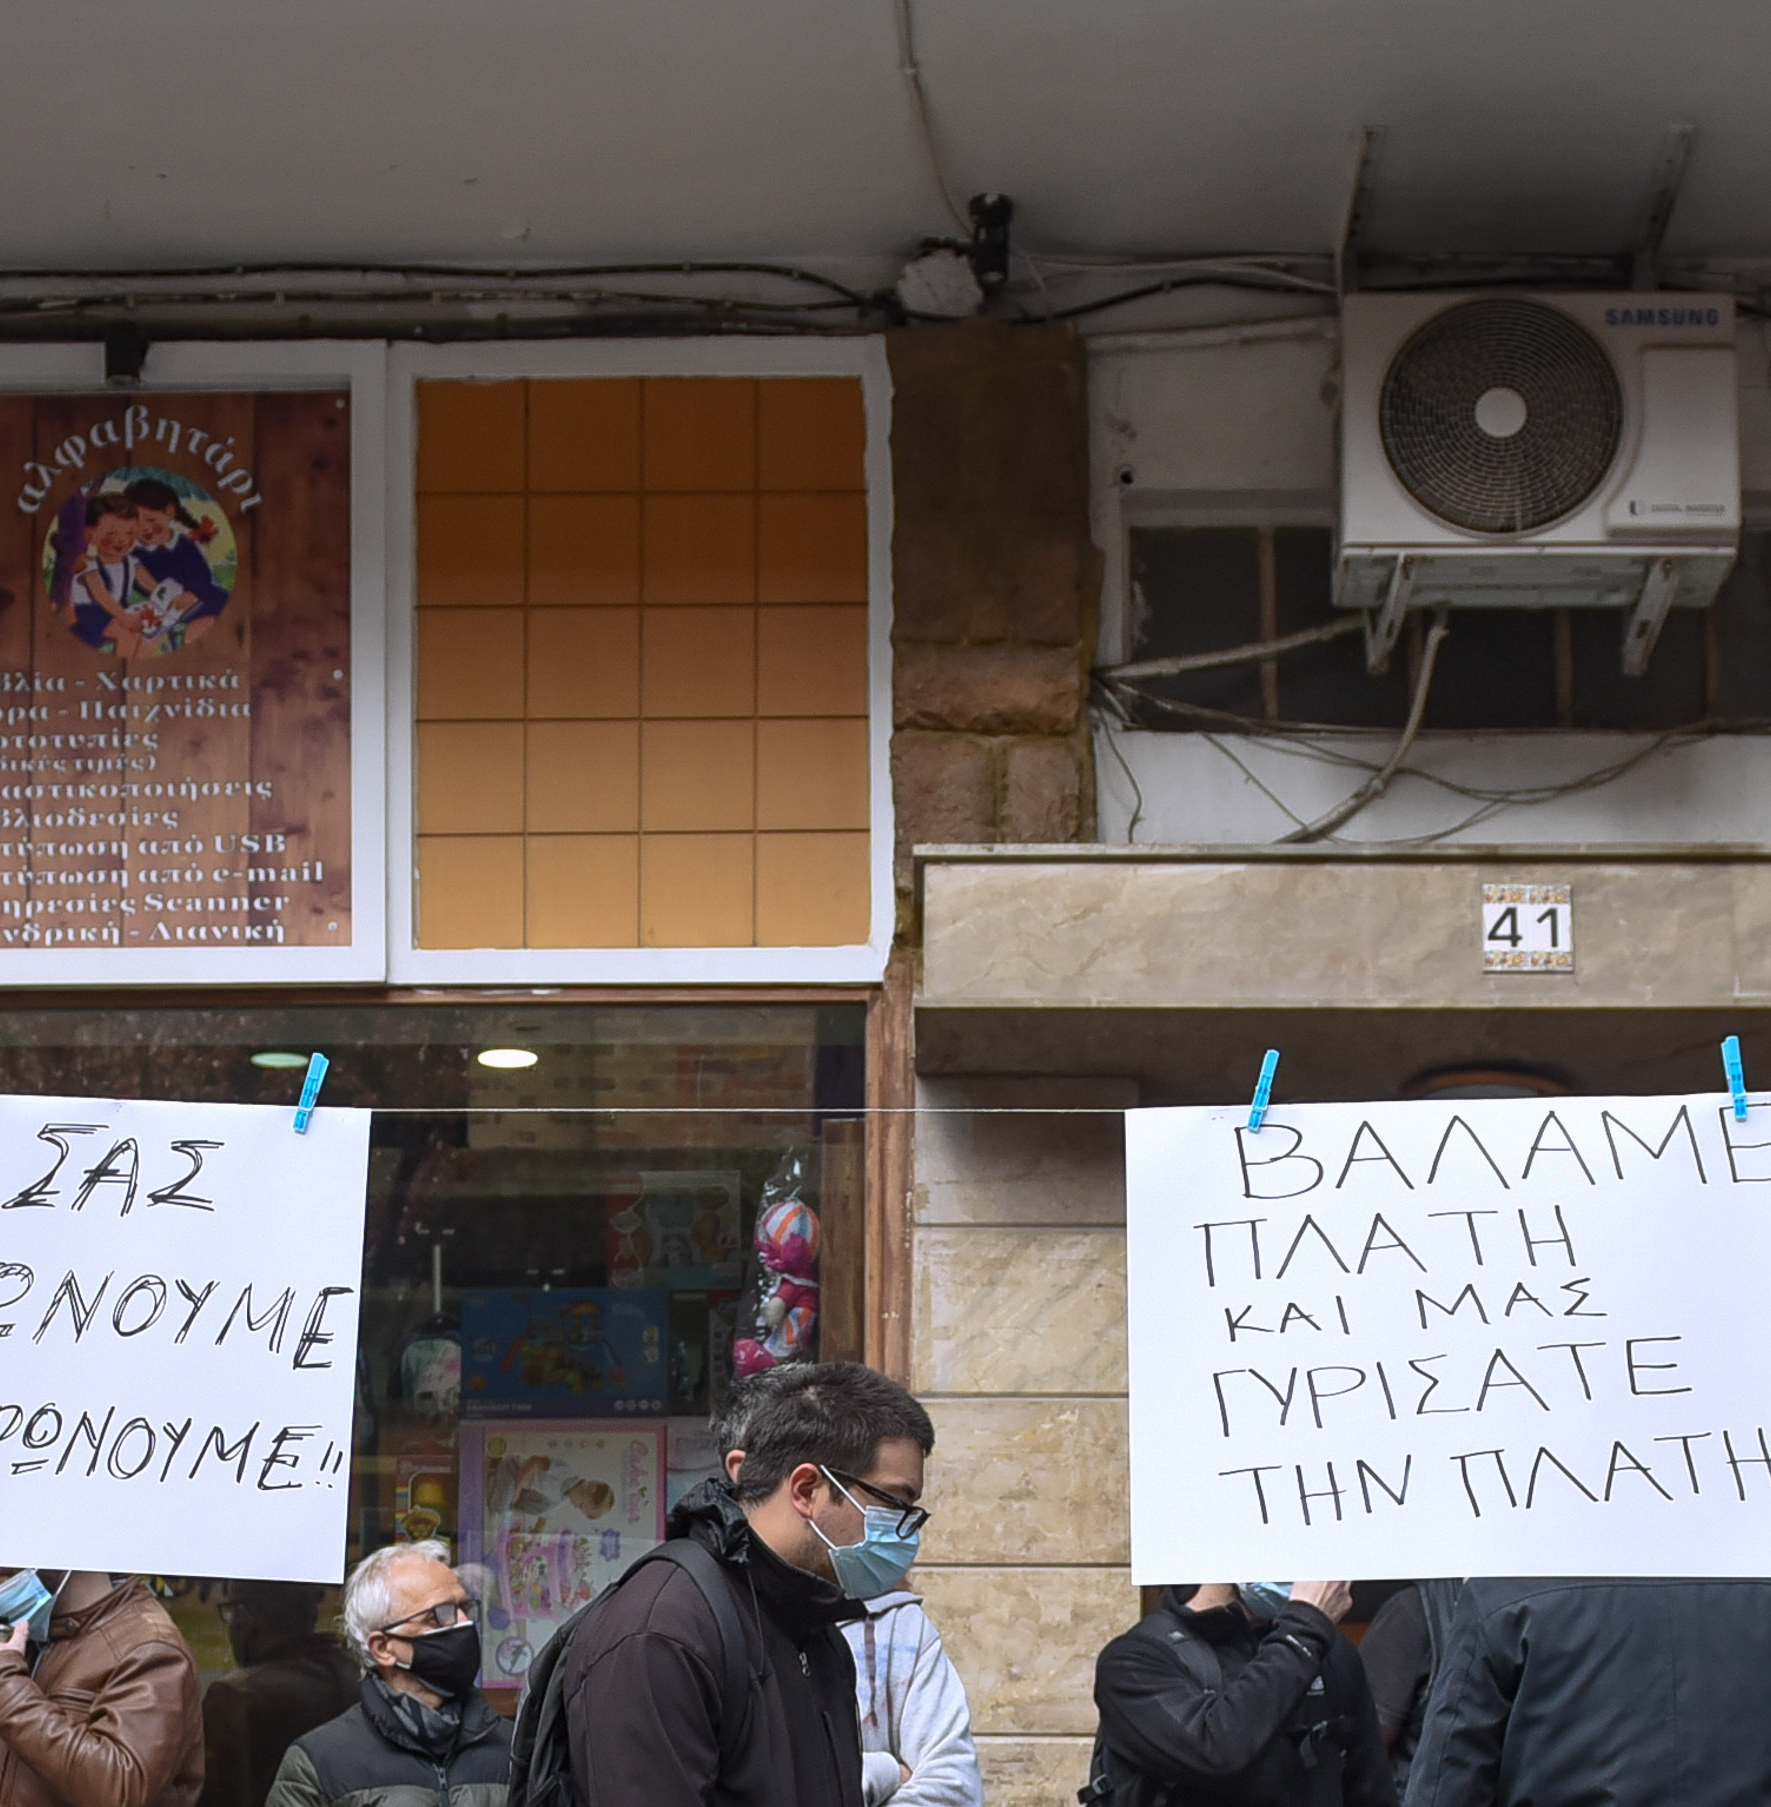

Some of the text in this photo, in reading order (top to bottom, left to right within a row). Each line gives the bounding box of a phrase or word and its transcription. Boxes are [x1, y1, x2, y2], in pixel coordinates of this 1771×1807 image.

[1606, 307, 1719, 326] SAMSUNG
[16, 403, 263, 514] αλφαβητάρι
[95, 669, 240, 694] Χαρτικά
[79, 697, 252, 723] Παιχνίδια
[138, 834, 204, 854] από
[213, 833, 288, 854] USB
[138, 863, 205, 883] από
[212, 861, 325, 883] e-mail
[144, 891, 291, 912] Scanner
[149, 920, 285, 944] Λιανική
[1487, 906, 1559, 948] 41
[1, 1122, 226, 1217] ΣΑΣ
[1192, 1204, 1577, 1287] ΠΛΑΤΗ
[1224, 1277, 1608, 1342] ΚΑΙ ΜΑΣ
[1212, 1335, 1694, 1438] ΓΥΡΙΣΑΤΕ
[1218, 1453, 1412, 1526] ΤΗΝ
